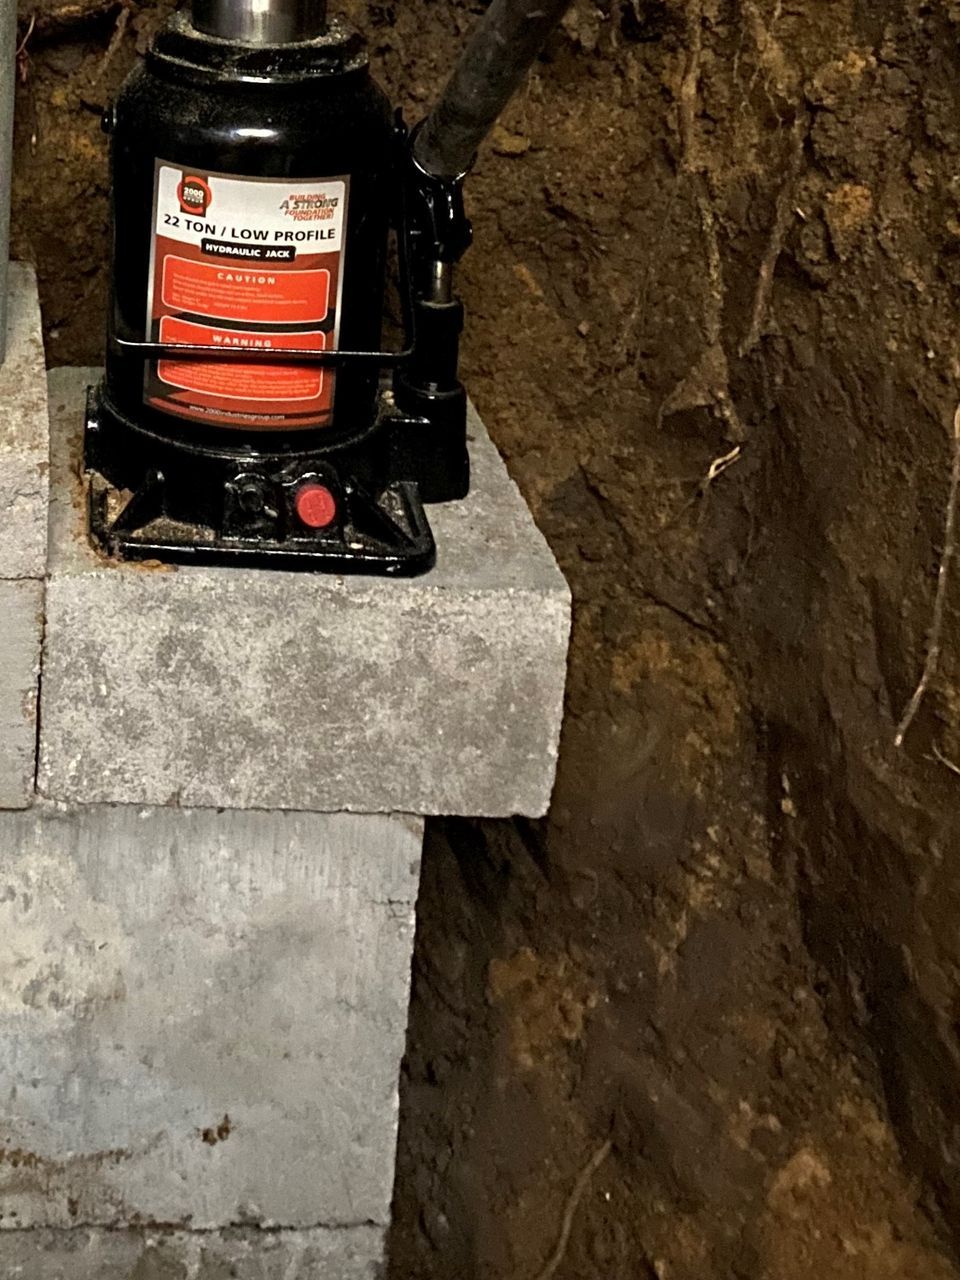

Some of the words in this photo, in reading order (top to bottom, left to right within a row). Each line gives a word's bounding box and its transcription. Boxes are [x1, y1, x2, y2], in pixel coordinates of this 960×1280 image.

[279, 200, 289, 209] A
[292, 198, 338, 209] STRONG
[164, 214, 180, 227] 22
[184, 219, 216, 235] TON
[221, 226, 226, 237] /
[231, 227, 269, 240] LOW
[274, 228, 336, 241] PROFILE
[205, 243, 261, 257] HYDRAULIC
[265, 248, 290, 258] JACK
[217, 272, 276, 284] CAUTION
[212, 335, 271, 347] WARNING
